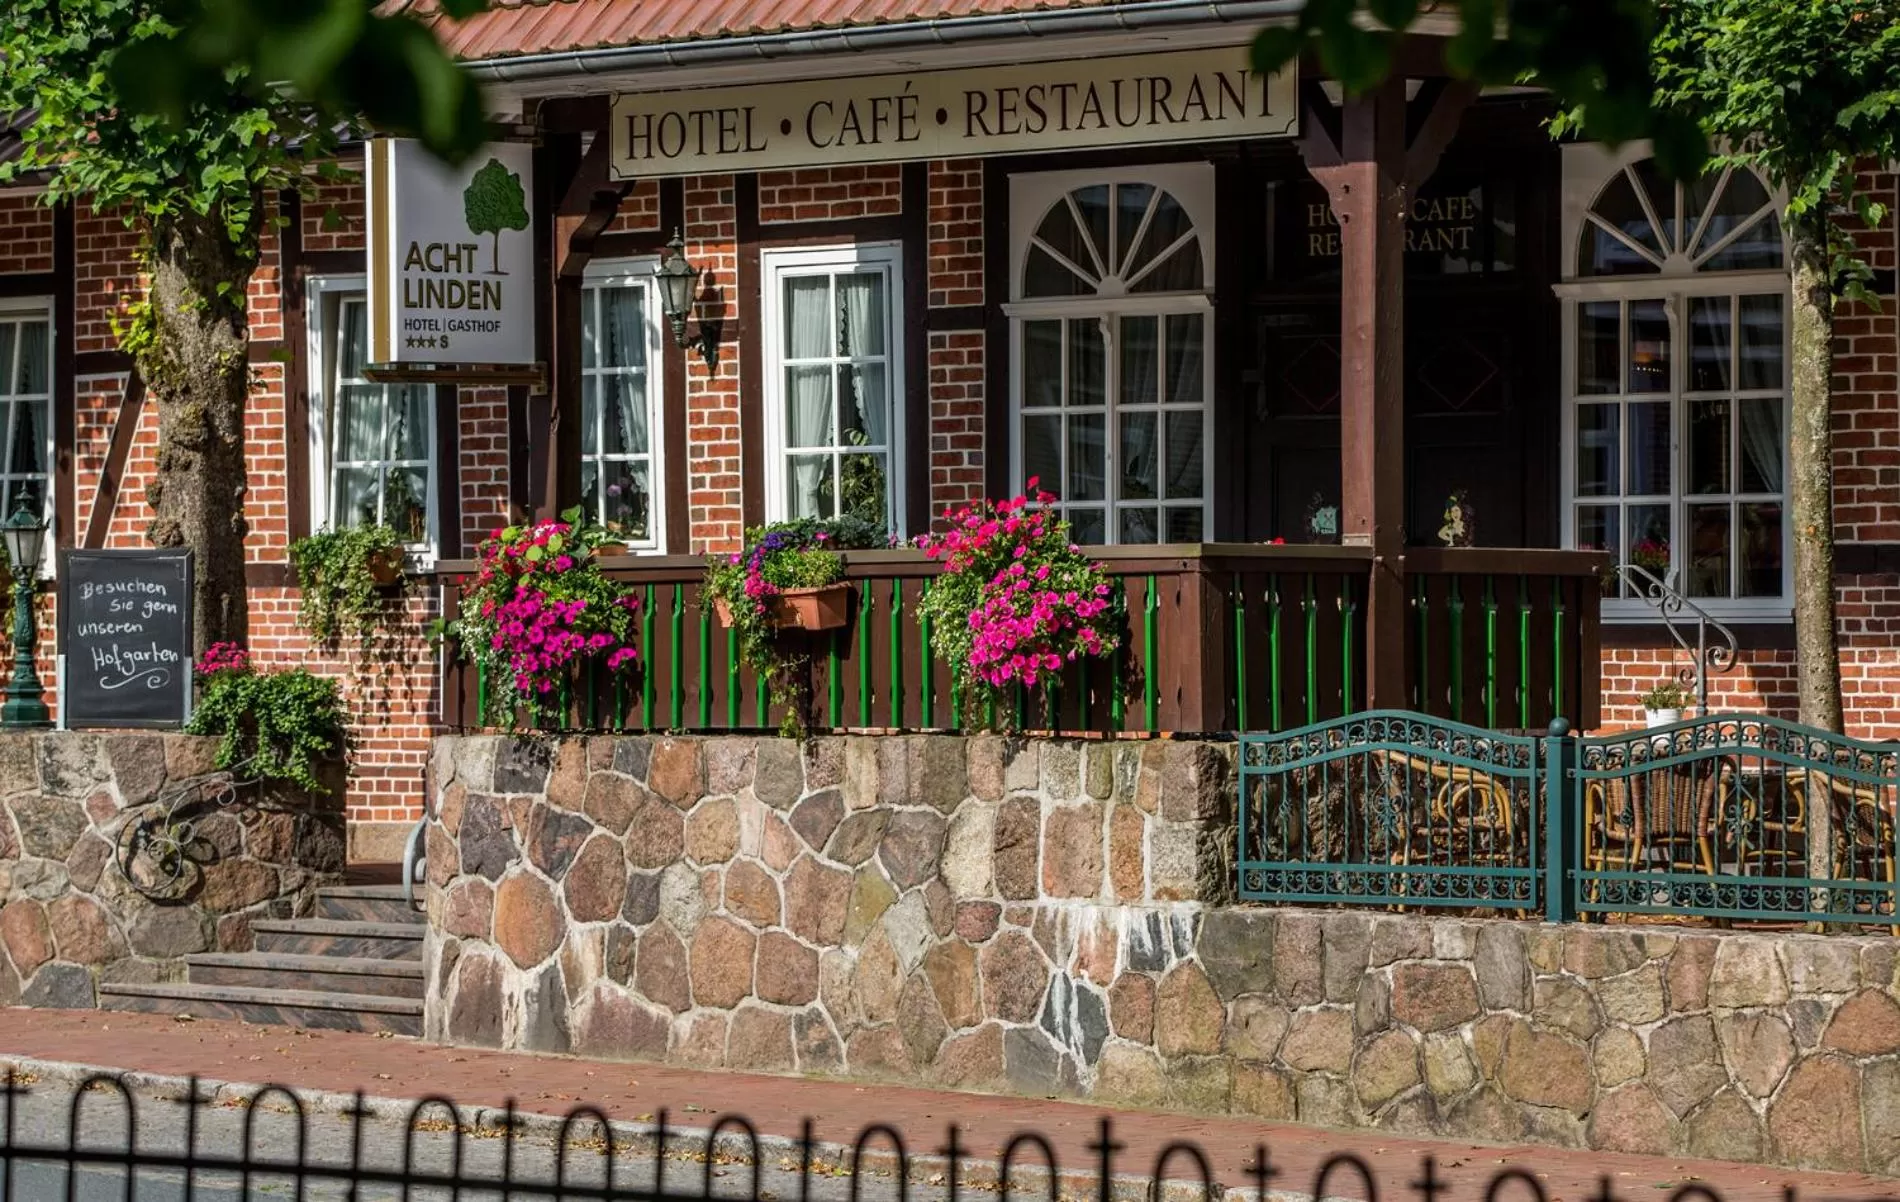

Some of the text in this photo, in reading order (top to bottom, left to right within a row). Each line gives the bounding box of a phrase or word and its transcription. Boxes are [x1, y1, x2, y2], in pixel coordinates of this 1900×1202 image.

[625, 69, 1282, 161] HOTEL CAFÉ RESTAURANT
[1412, 196, 1475, 221] CAFE
[1307, 226, 1475, 256] RERANT
[403, 241, 478, 273] ACHT
[403, 278, 501, 311] LINDEN
[404, 318, 501, 332] HOTEL GASTHOF
[80, 577, 167, 600] Besuchen
[110, 599, 177, 618] Sie gern
[78, 622, 143, 636] unseren
[91, 641, 179, 676] Hofgarten
